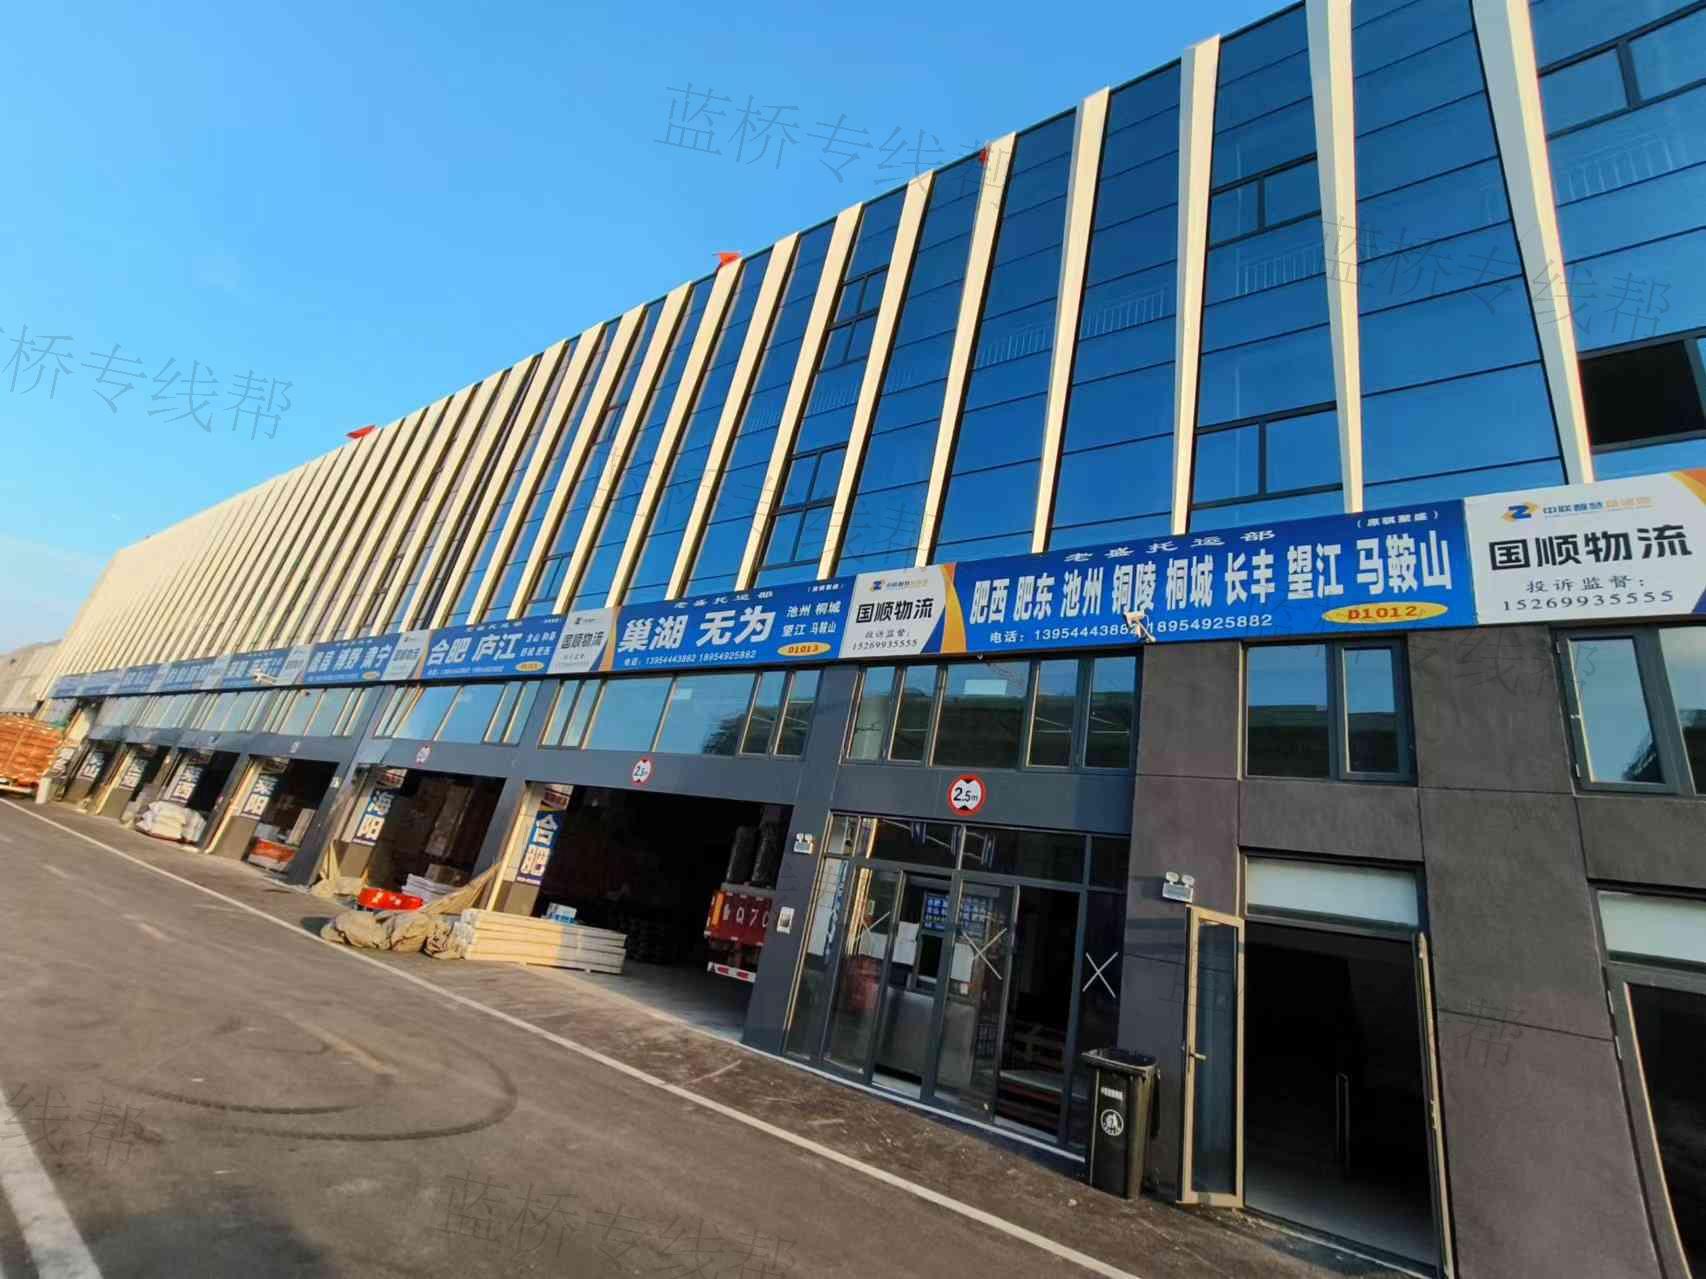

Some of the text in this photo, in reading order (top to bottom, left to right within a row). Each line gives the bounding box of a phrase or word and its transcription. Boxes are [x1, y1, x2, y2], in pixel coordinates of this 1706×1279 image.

[1489, 524, 1692, 571] 国顺物流
[970, 530, 1452, 625] 肥西 肥东 池州 铜陵 桐城 长丰 望江 马鞍山
[786, 604, 811, 618] 池州
[856, 598, 934, 623] 国顺物流
[1503, 590, 1674, 611] 15269935555
[617, 606, 776, 652] 巢湖 无为
[781, 621, 836, 637] 望江 马鞍山
[427, 637, 472, 666] 合肥
[472, 633, 523, 661] 庐江
